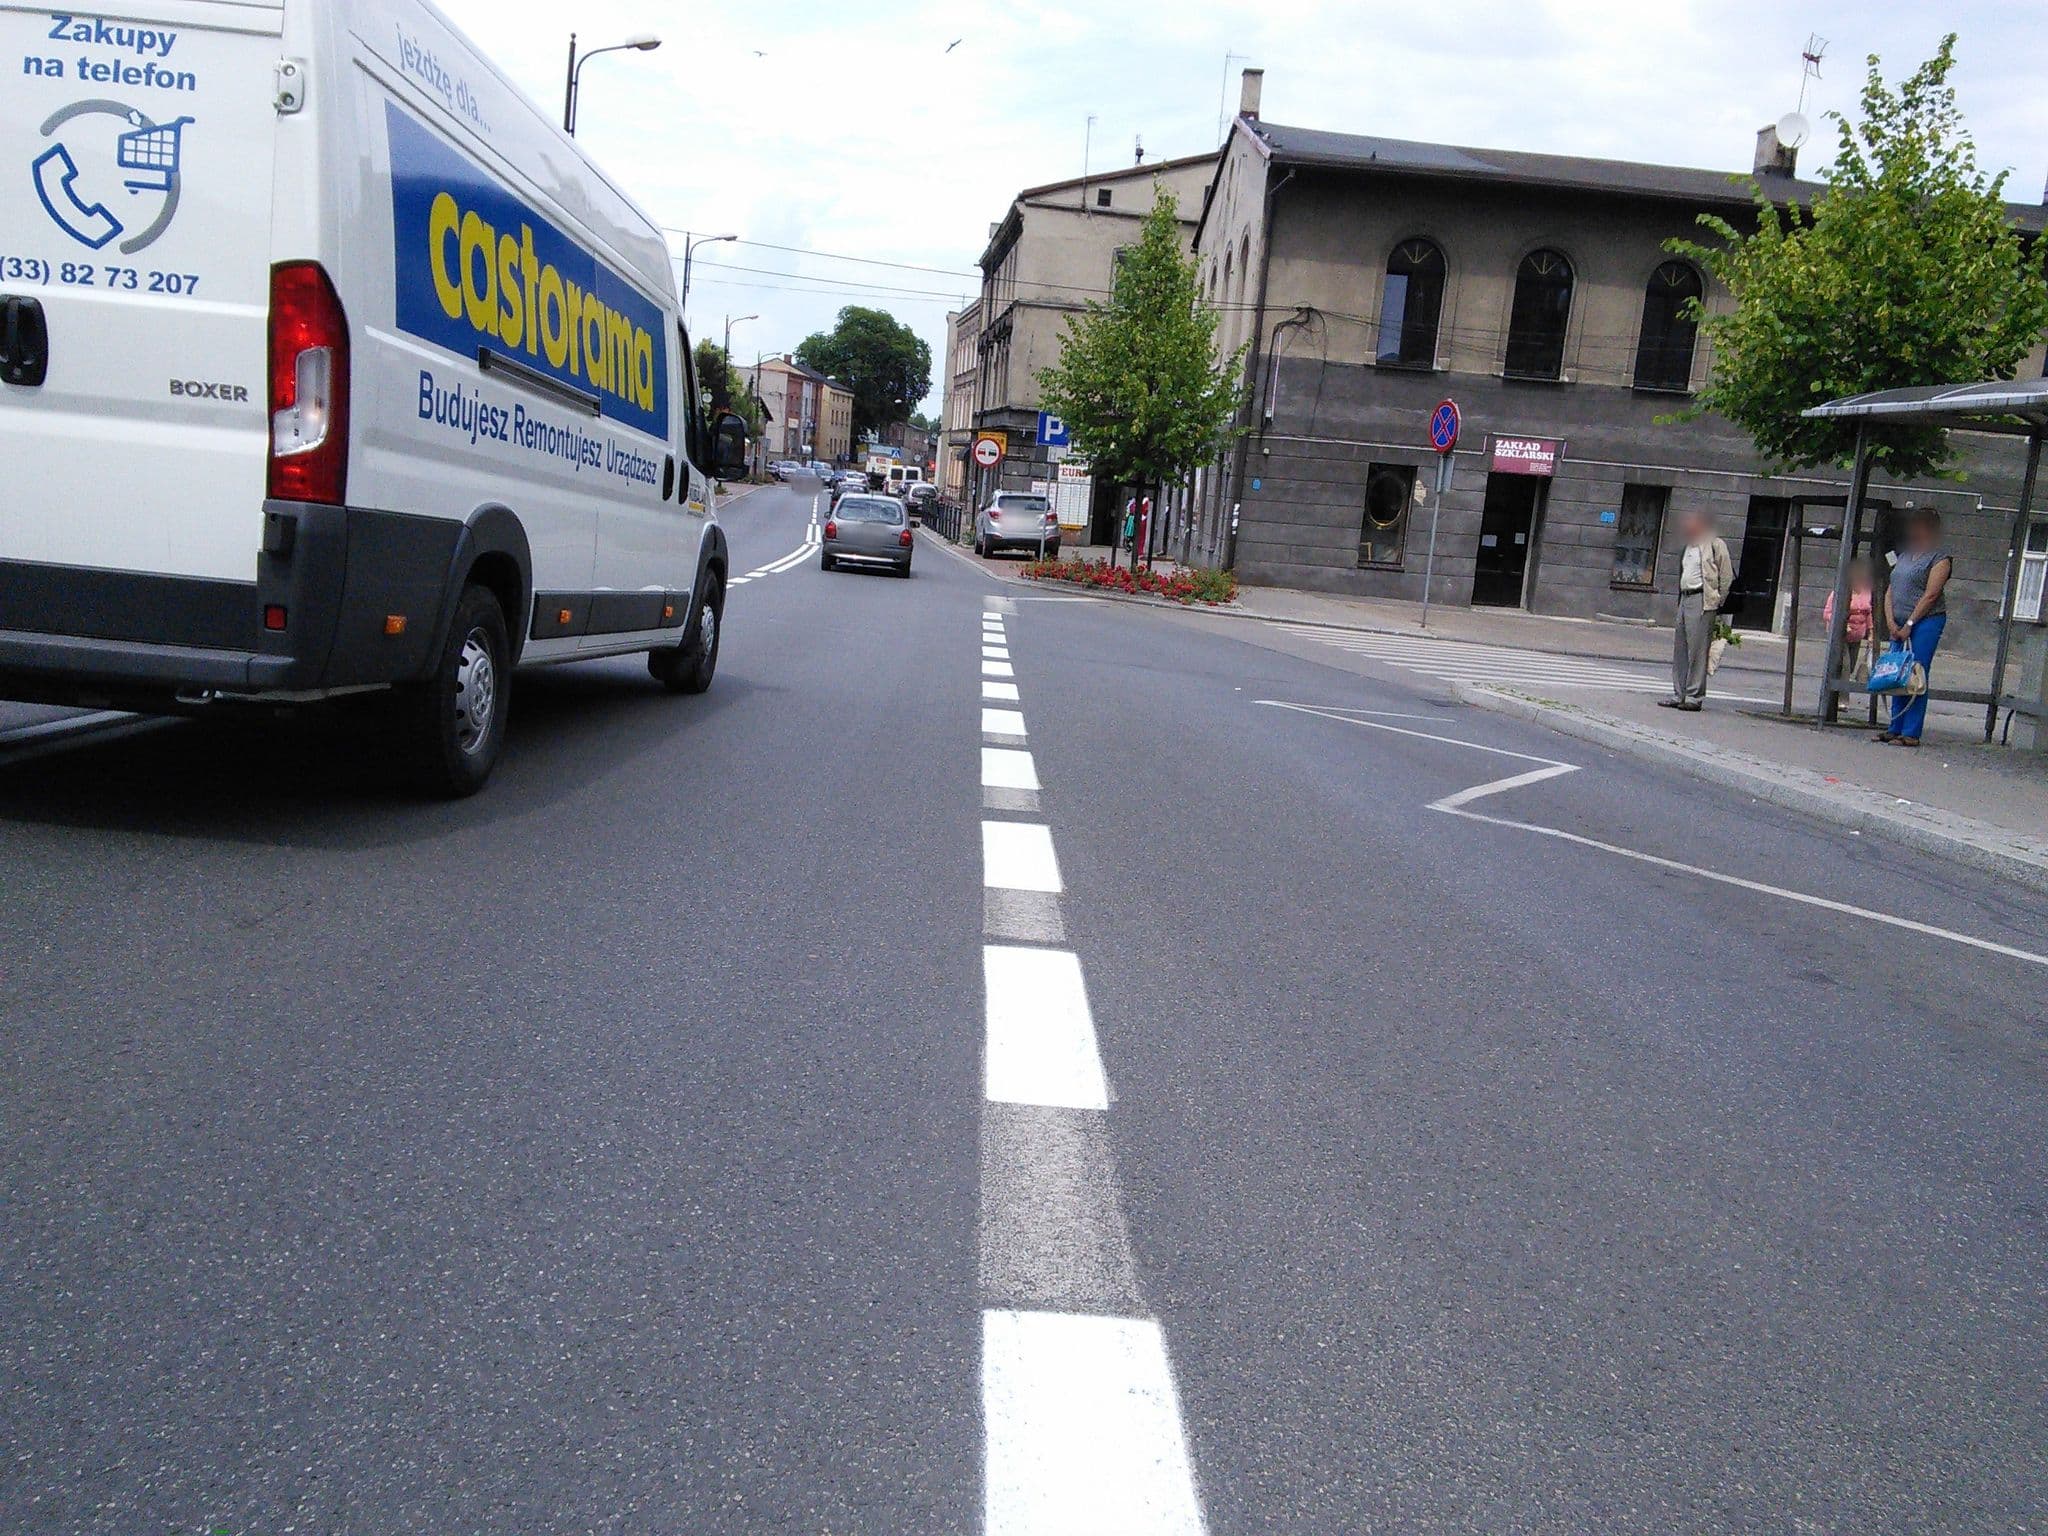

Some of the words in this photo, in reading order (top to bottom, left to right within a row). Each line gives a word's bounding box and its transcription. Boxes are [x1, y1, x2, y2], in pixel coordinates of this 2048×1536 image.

[48, 15, 177, 57] Zakupy
[24, 56, 64, 78] na
[77, 56, 196, 91] telefon
[396, 23, 453, 110] jeżdżę
[0, 255, 50, 286] (33)
[60, 262, 94, 285] 82
[104, 266, 138, 290] 73
[148, 271, 199, 295] 207
[429, 192, 654, 412] castorama
[170, 379, 248, 402] BOXER
[418, 370, 509, 445] Budujesz
[513, 404, 601, 472] Remontujesz
[606, 438, 657, 486] Urządzasz
[1045, 415, 1064, 441] P
[1494, 448, 1555, 461] SZKLARSKI
